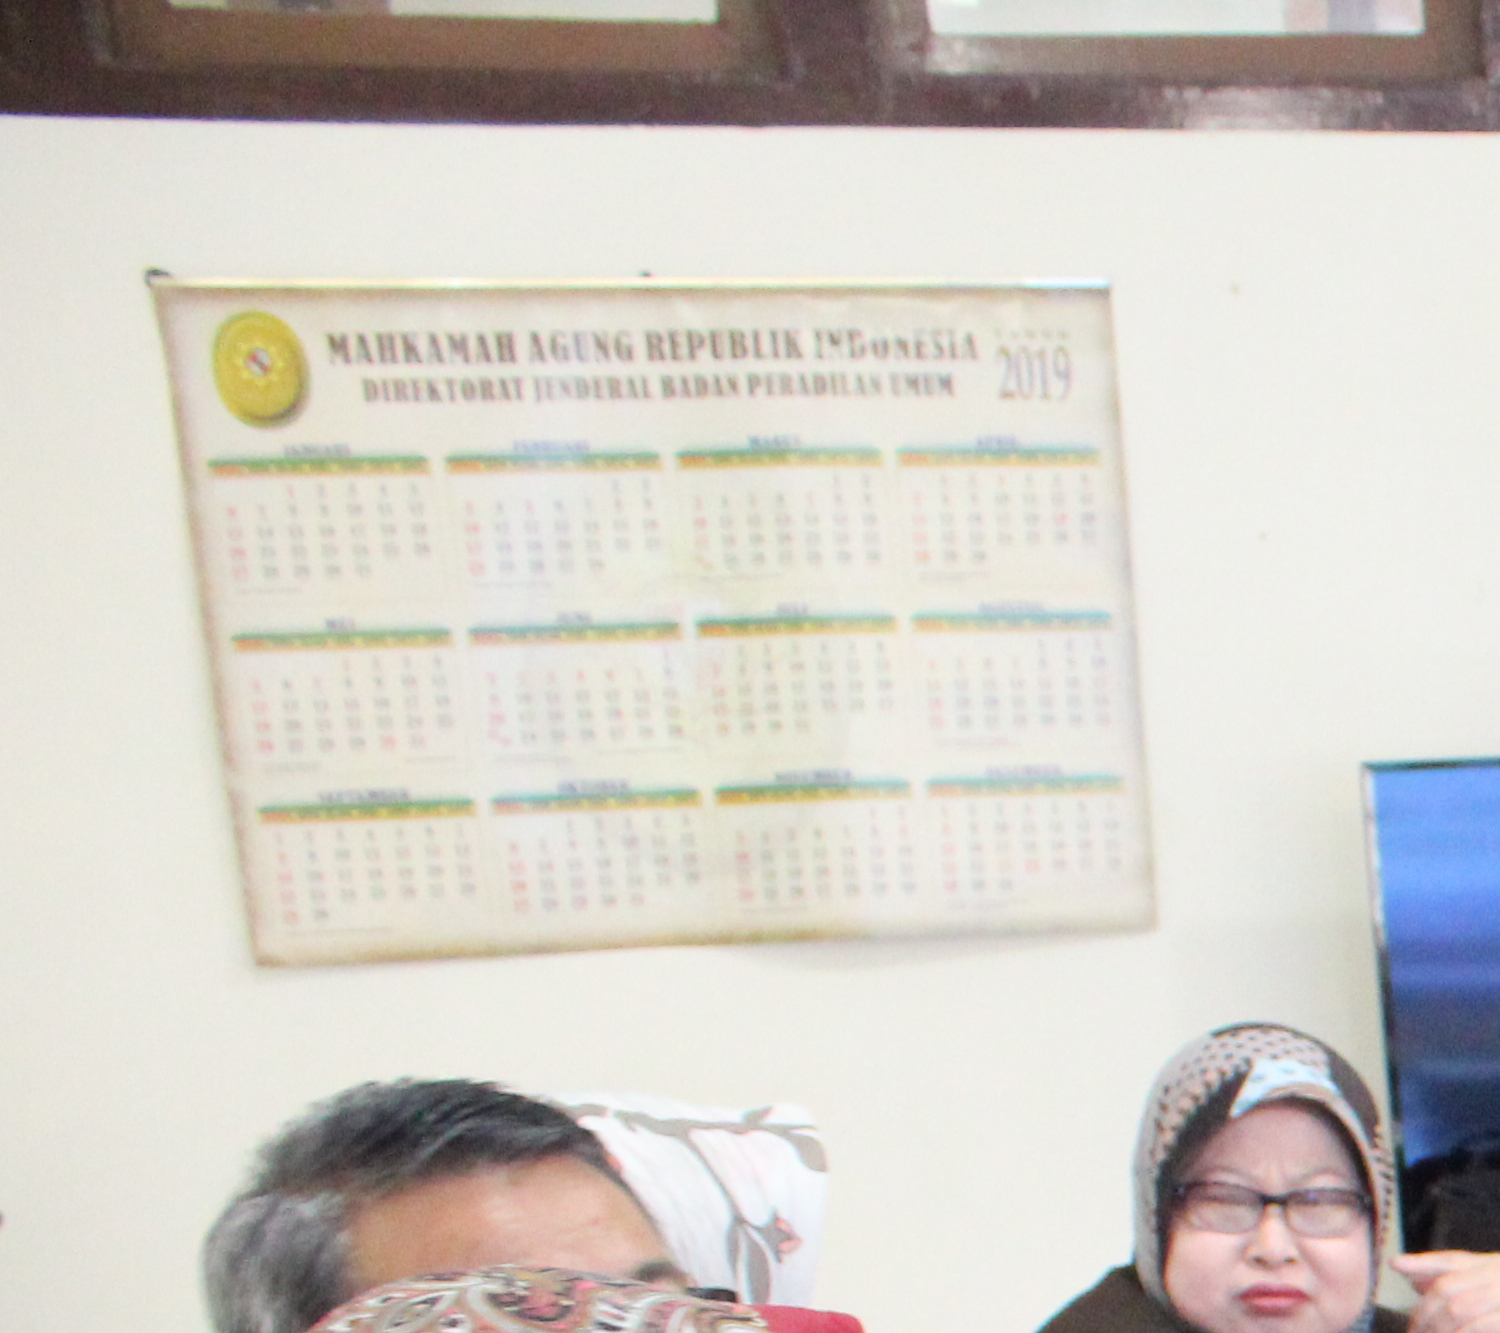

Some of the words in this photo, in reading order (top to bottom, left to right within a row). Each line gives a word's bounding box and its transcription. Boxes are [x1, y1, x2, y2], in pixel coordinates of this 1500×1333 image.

[326, 331, 518, 364] MAHKAMAH
[528, 330, 635, 363] AGUNG
[645, 328, 804, 362] REPUBLIK
[362, 377, 525, 403] DIREKTORAT
[534, 375, 652, 403] JENDERAL
[659, 374, 741, 400] BADAN
[747, 372, 883, 398] PERADILAN
[889, 371, 956, 397] UMUM
[998, 344, 1073, 401] 2019
